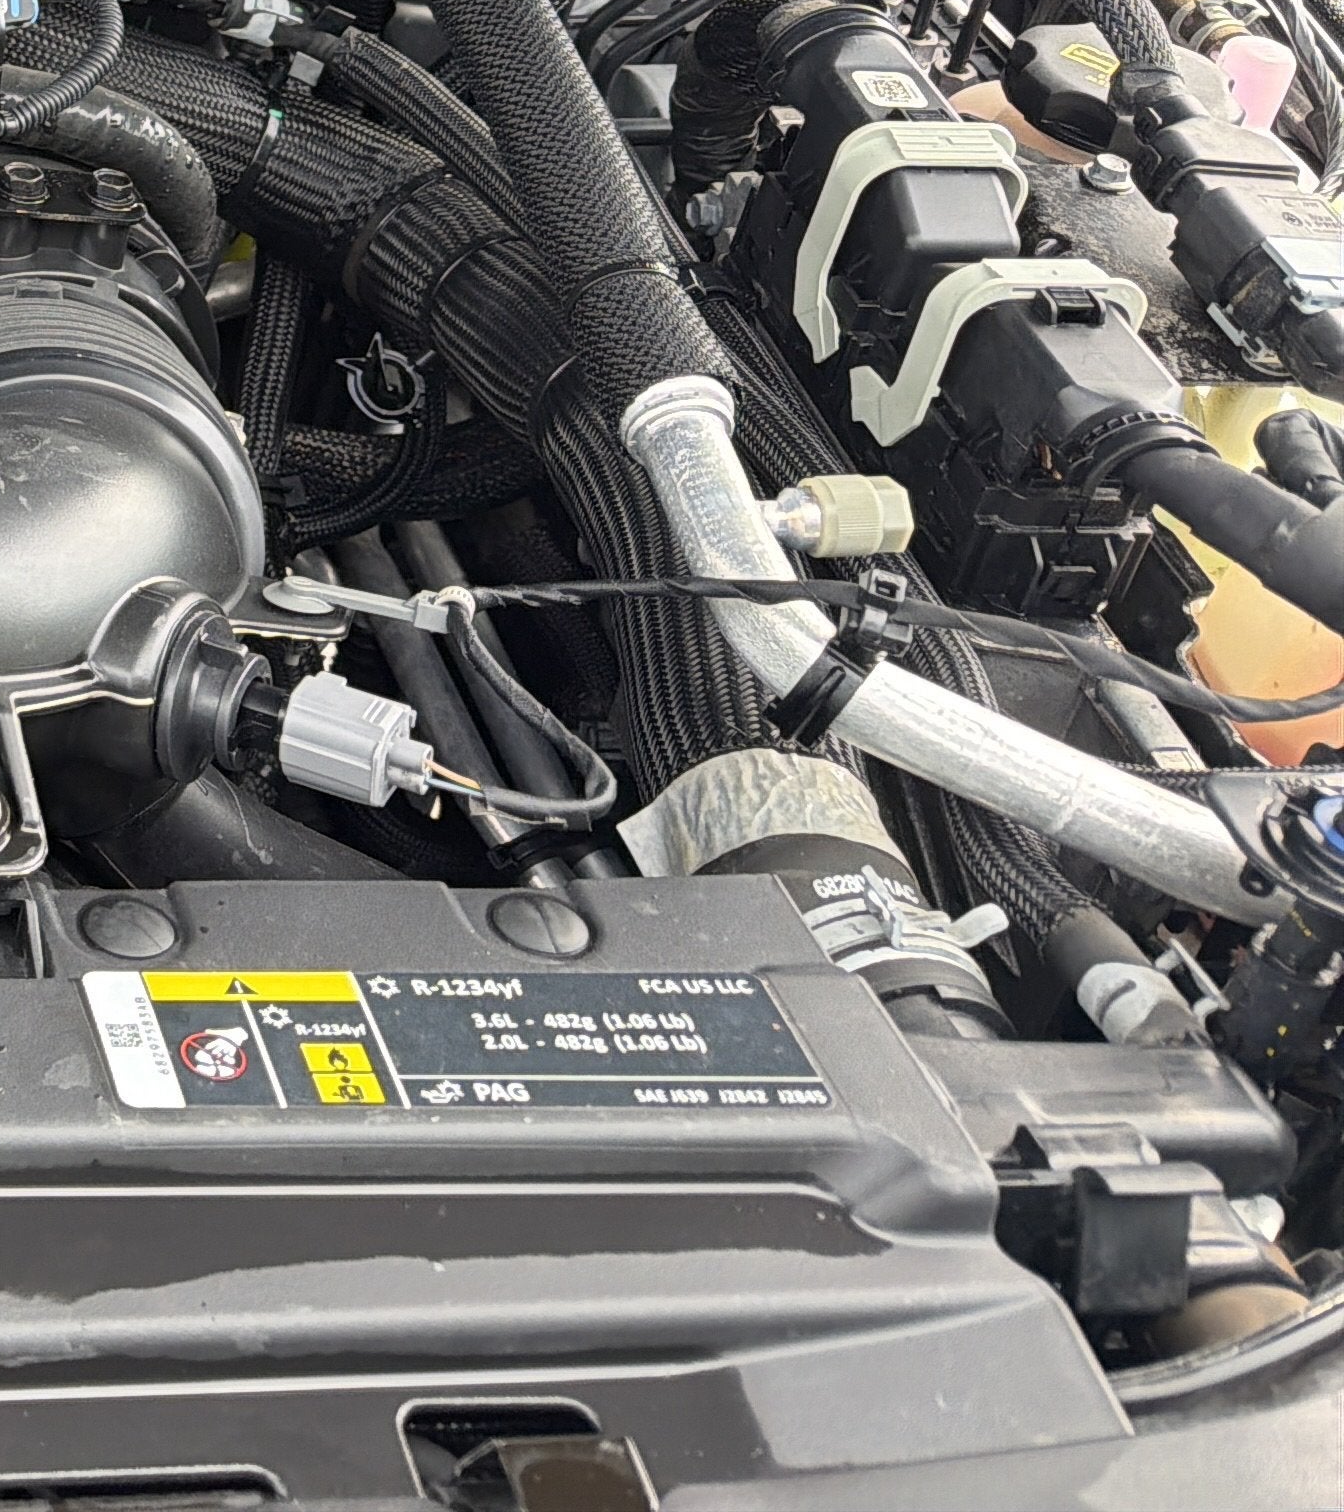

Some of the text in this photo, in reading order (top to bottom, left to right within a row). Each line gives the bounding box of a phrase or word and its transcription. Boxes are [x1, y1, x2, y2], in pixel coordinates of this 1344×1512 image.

[411, 978, 523, 999] R-1234yf
[638, 979, 754, 994] FCA US LLC
[294, 1023, 366, 1038] R-1234yf
[471, 1012, 518, 1029] 3.6L
[544, 1013, 598, 1032] 482g
[602, 1012, 658, 1031] (1.06
[658, 1013, 695, 1032] Lb)
[480, 1034, 529, 1050] 2.0L
[554, 1034, 609, 1053] 482g
[614, 1034, 669, 1053] (1.06
[670, 1035, 708, 1054] Lb)
[473, 1082, 530, 1102] PAG
[634, 1088, 668, 1103] SAE
